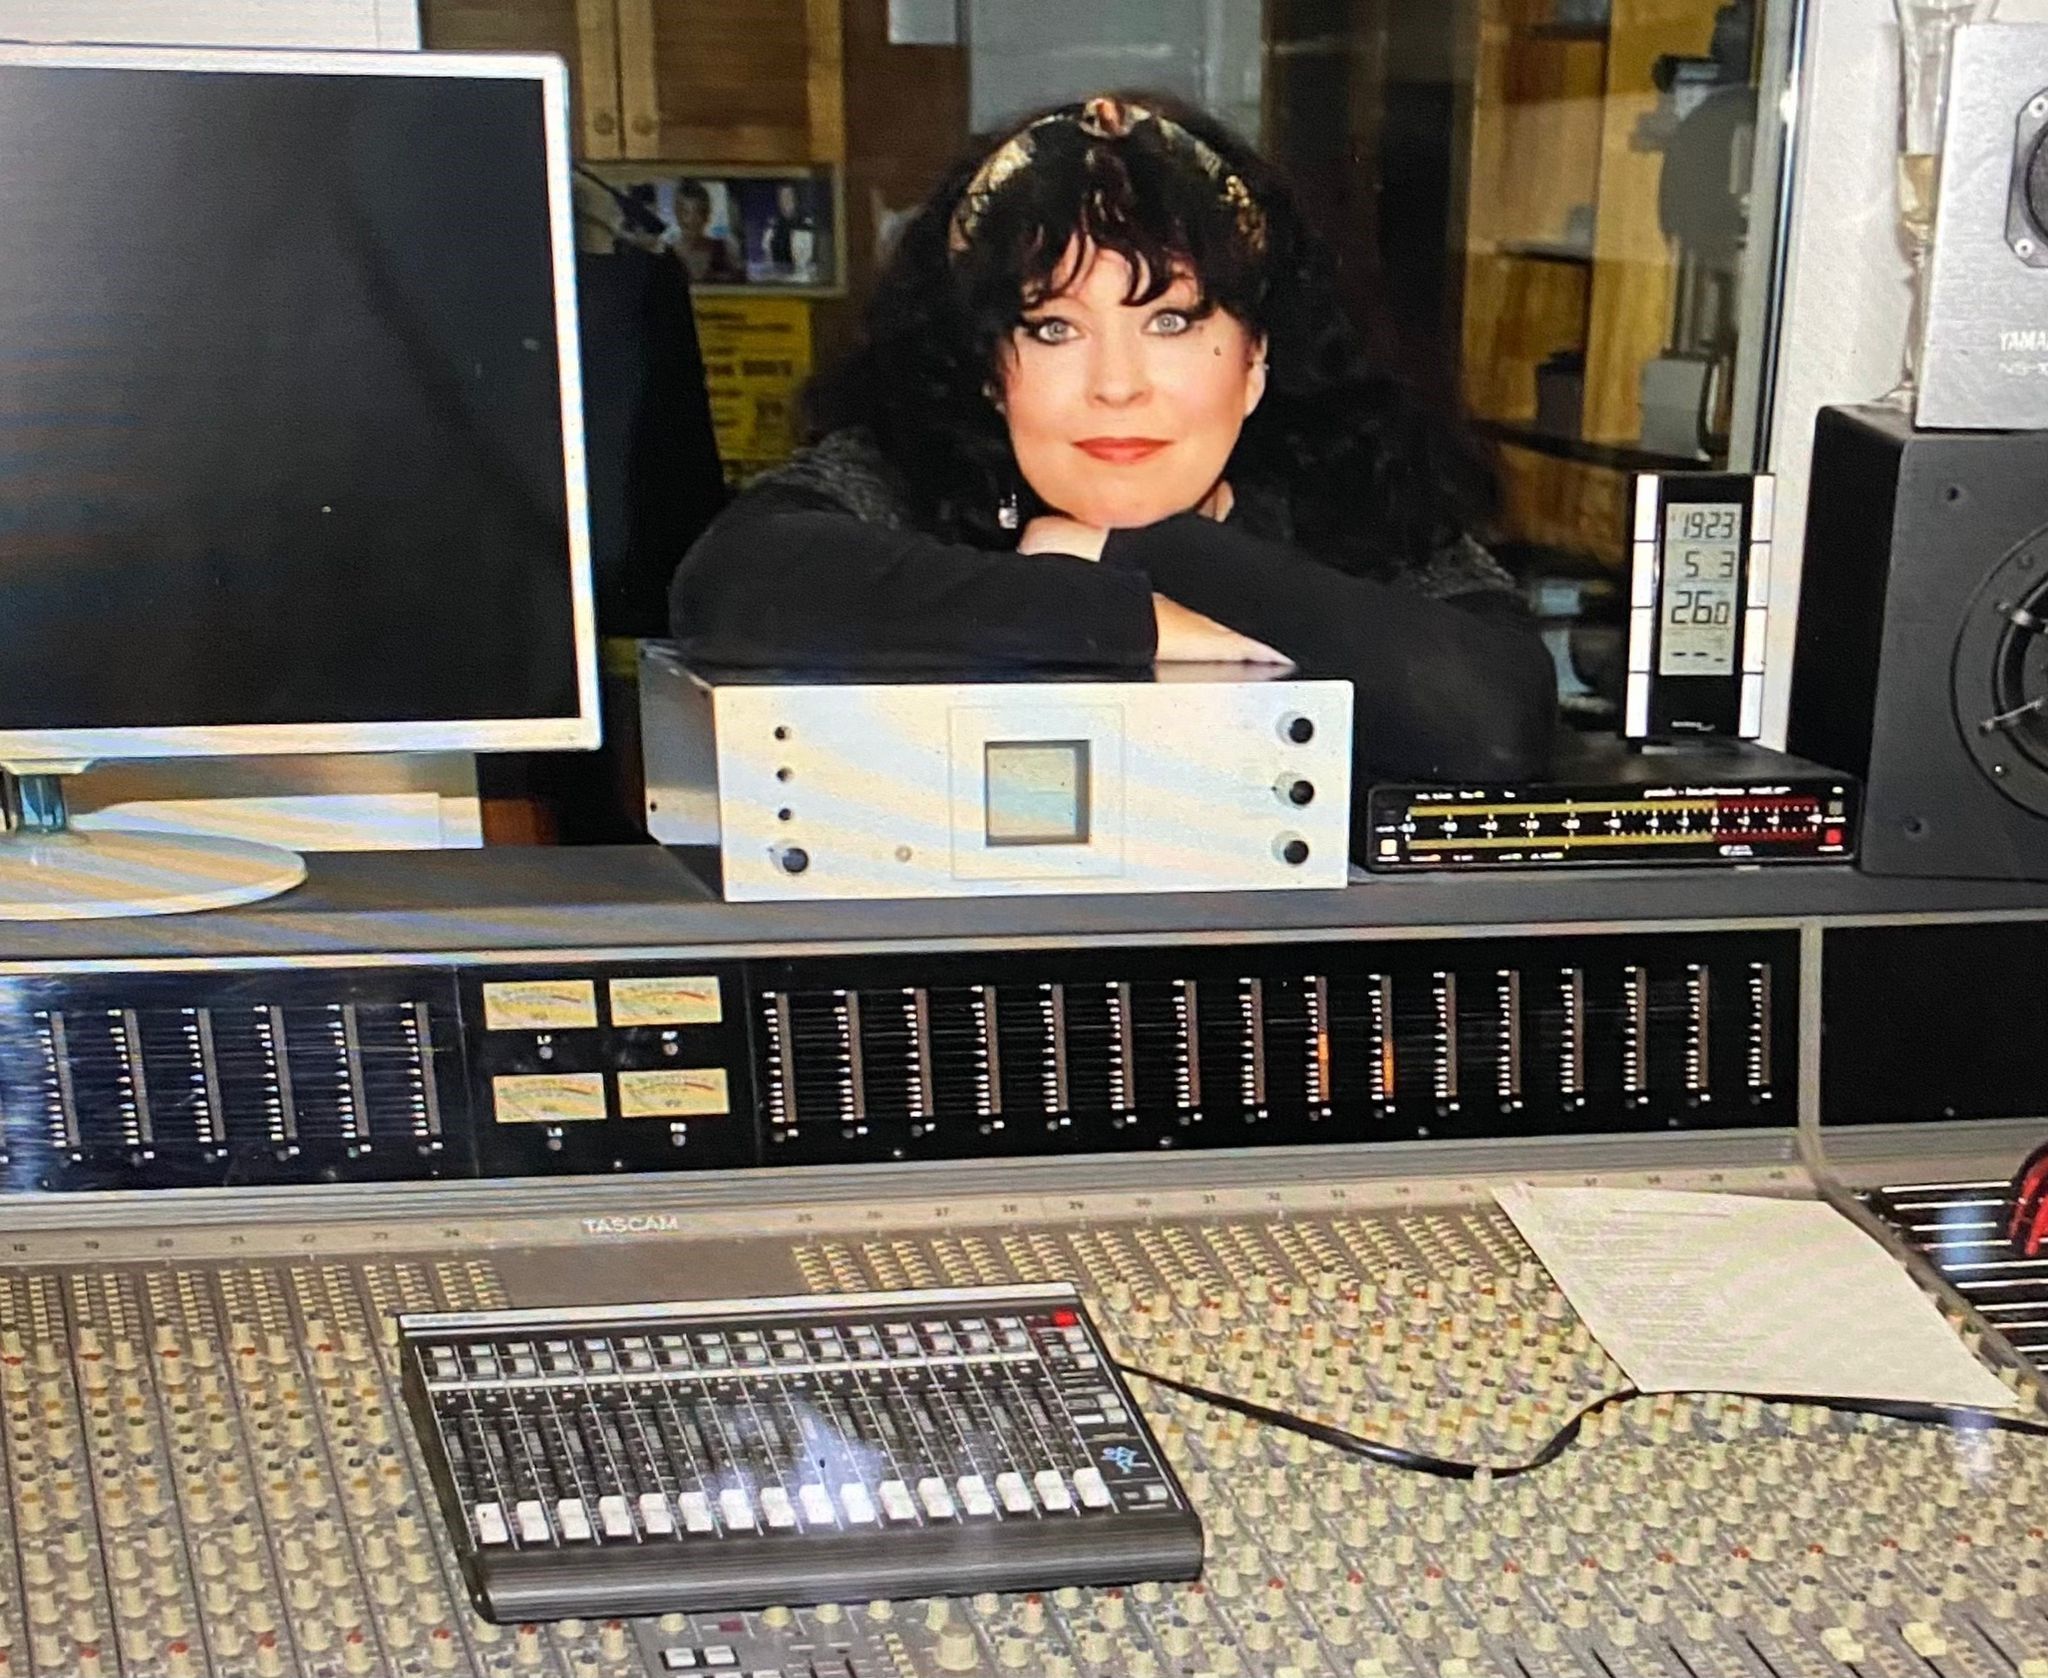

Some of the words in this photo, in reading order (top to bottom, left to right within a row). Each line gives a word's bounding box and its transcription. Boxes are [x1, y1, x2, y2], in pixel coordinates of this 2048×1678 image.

[1683, 511, 1735, 538] 1923
[1684, 550, 1700, 578] 5
[1719, 550, 1735, 578] 3
[582, 1215, 679, 1233] TASCAM
